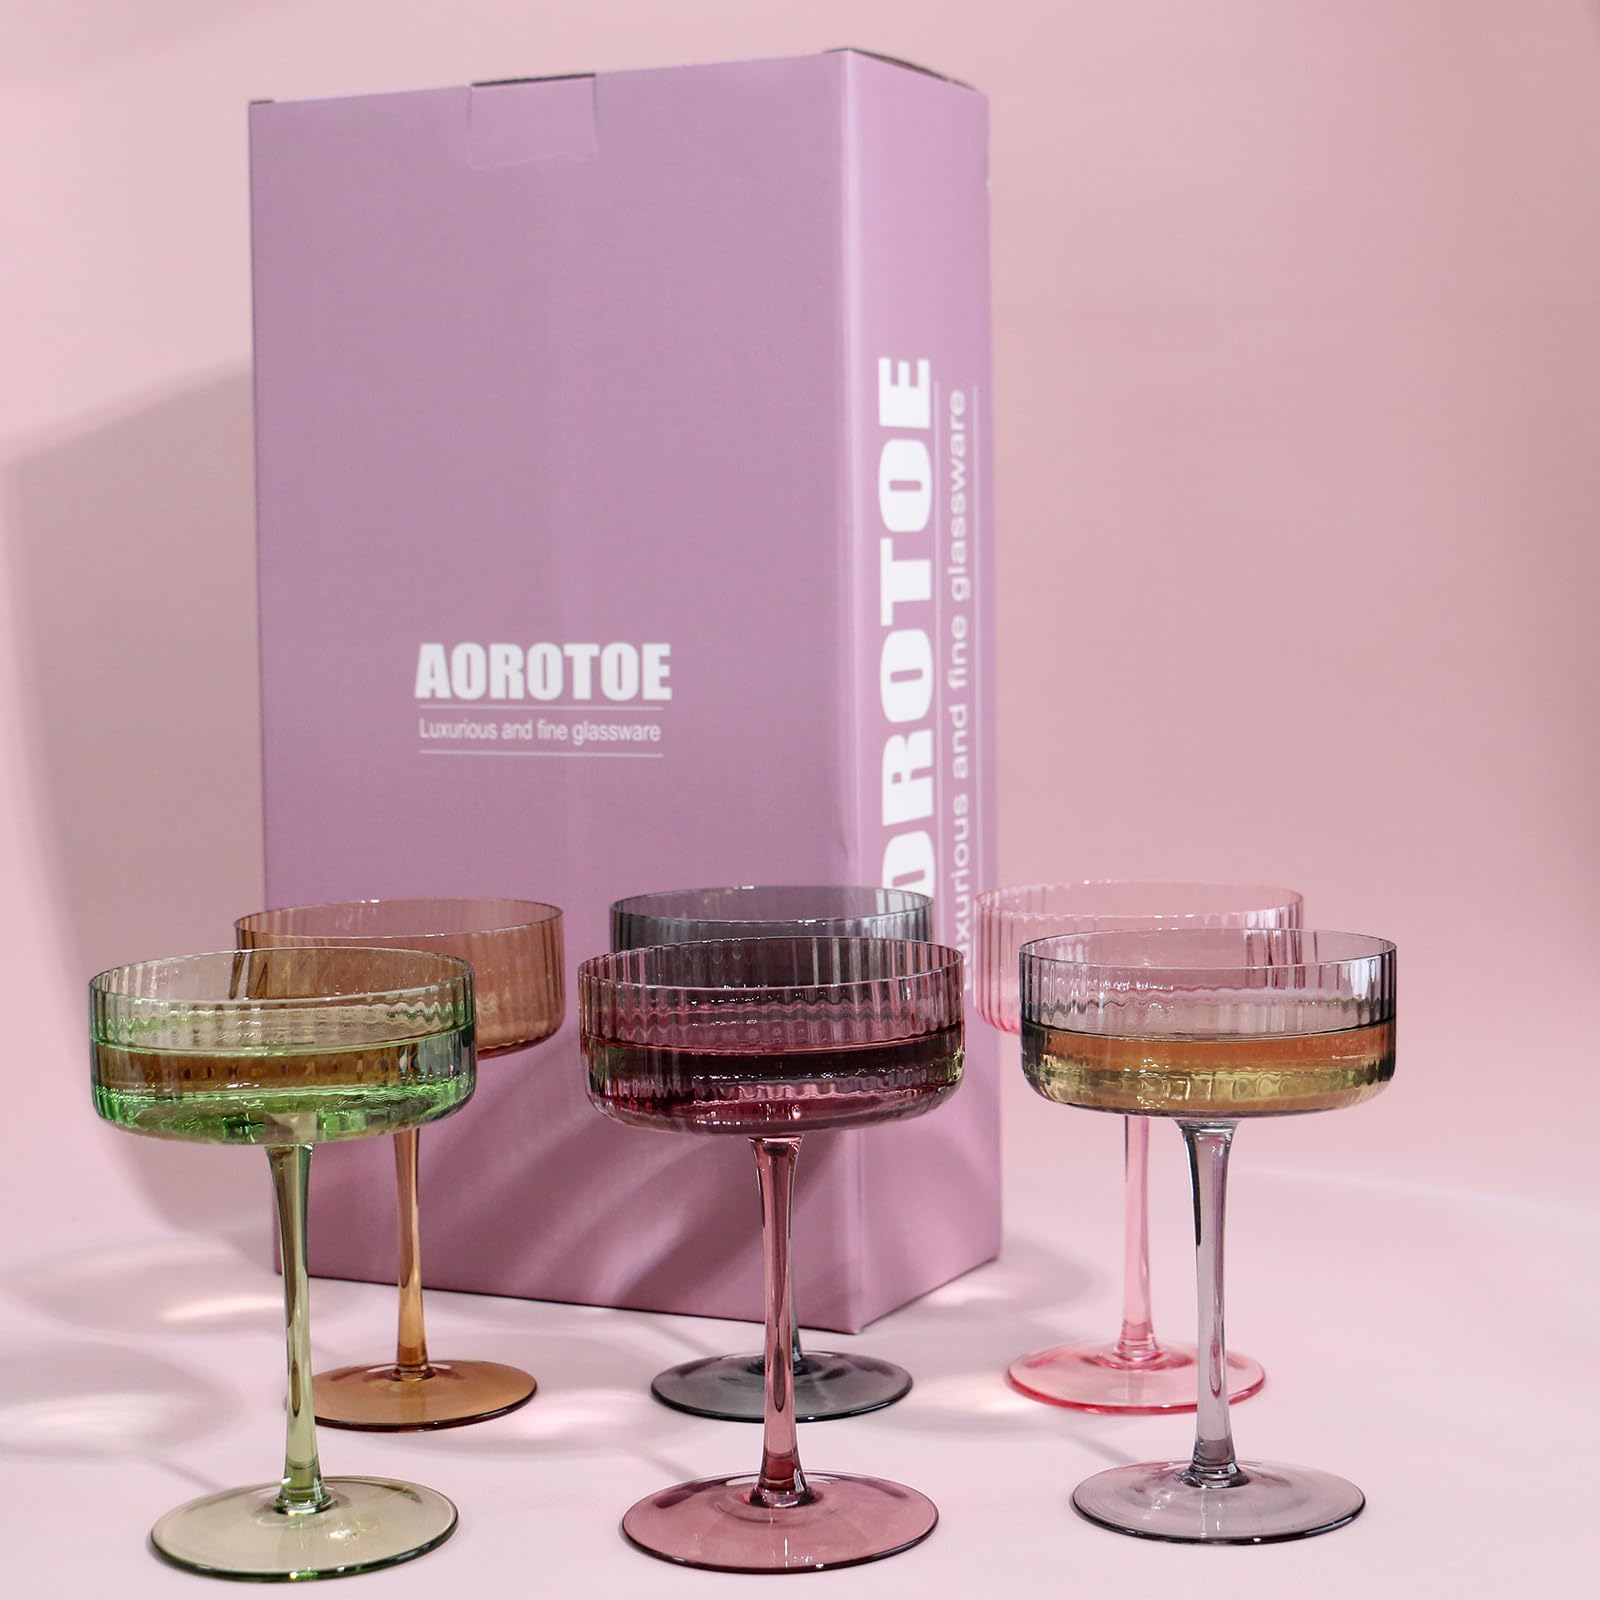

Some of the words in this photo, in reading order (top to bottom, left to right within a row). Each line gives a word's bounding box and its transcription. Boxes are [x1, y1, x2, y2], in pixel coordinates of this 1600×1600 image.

[947, 390, 970, 601] glassware
[878, 357, 935, 900] OROTOE
[947, 614, 968, 690] fine
[415, 642, 672, 701] AOROTOE
[419, 718, 498, 740] Luxurious
[502, 719, 532, 740] and
[537, 719, 568, 741] fine
[572, 720, 661, 746] glassware
[948, 703, 968, 780] and
